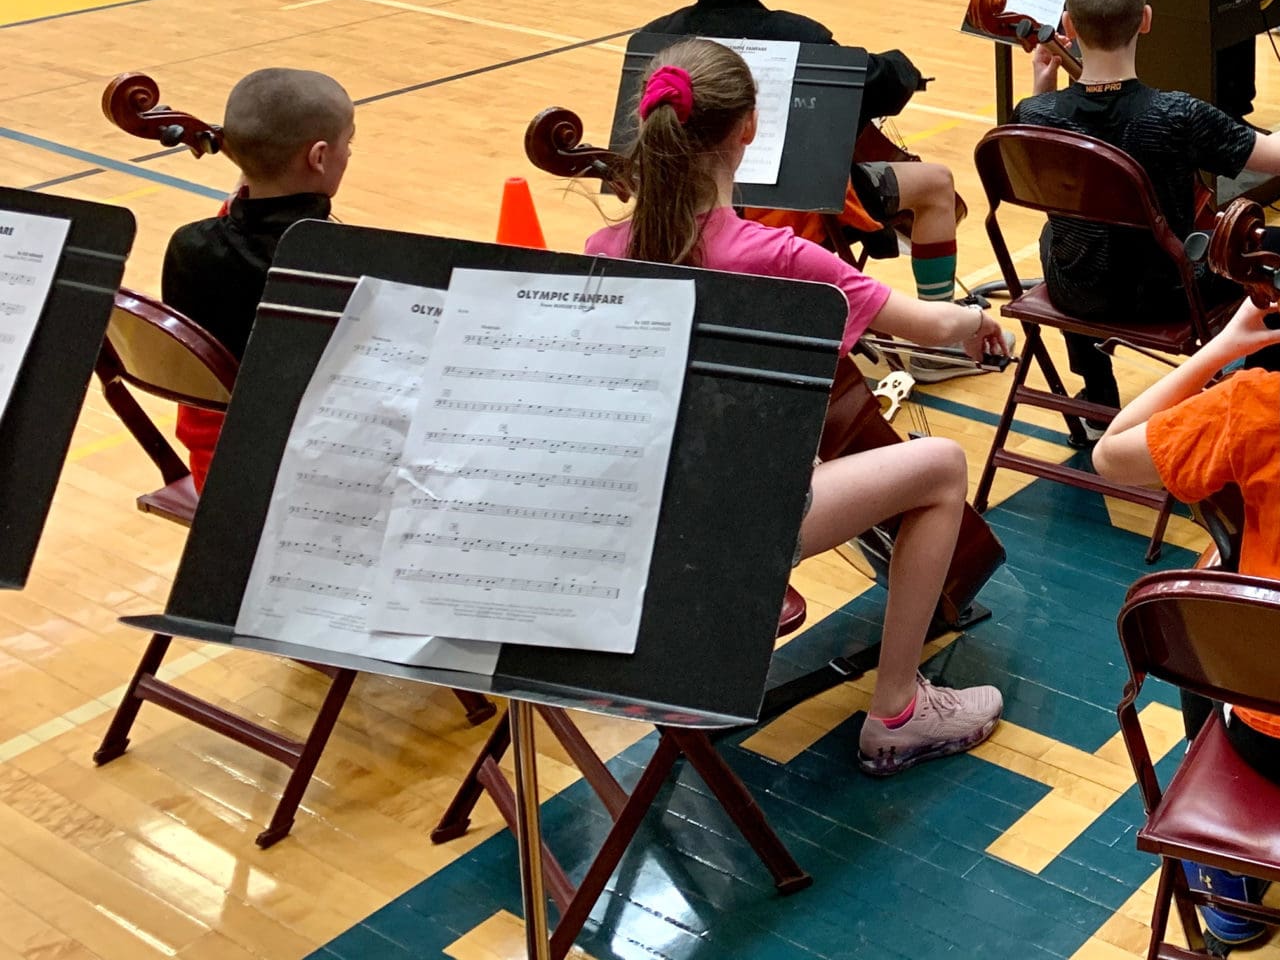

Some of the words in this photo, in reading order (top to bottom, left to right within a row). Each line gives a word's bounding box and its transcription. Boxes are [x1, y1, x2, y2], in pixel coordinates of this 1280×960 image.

[1085, 85, 1103, 93] NIKE
[1104, 82, 1121, 92] PRO
[516, 289, 569, 302] OLYMPIC
[572, 292, 625, 305] FANFARE
